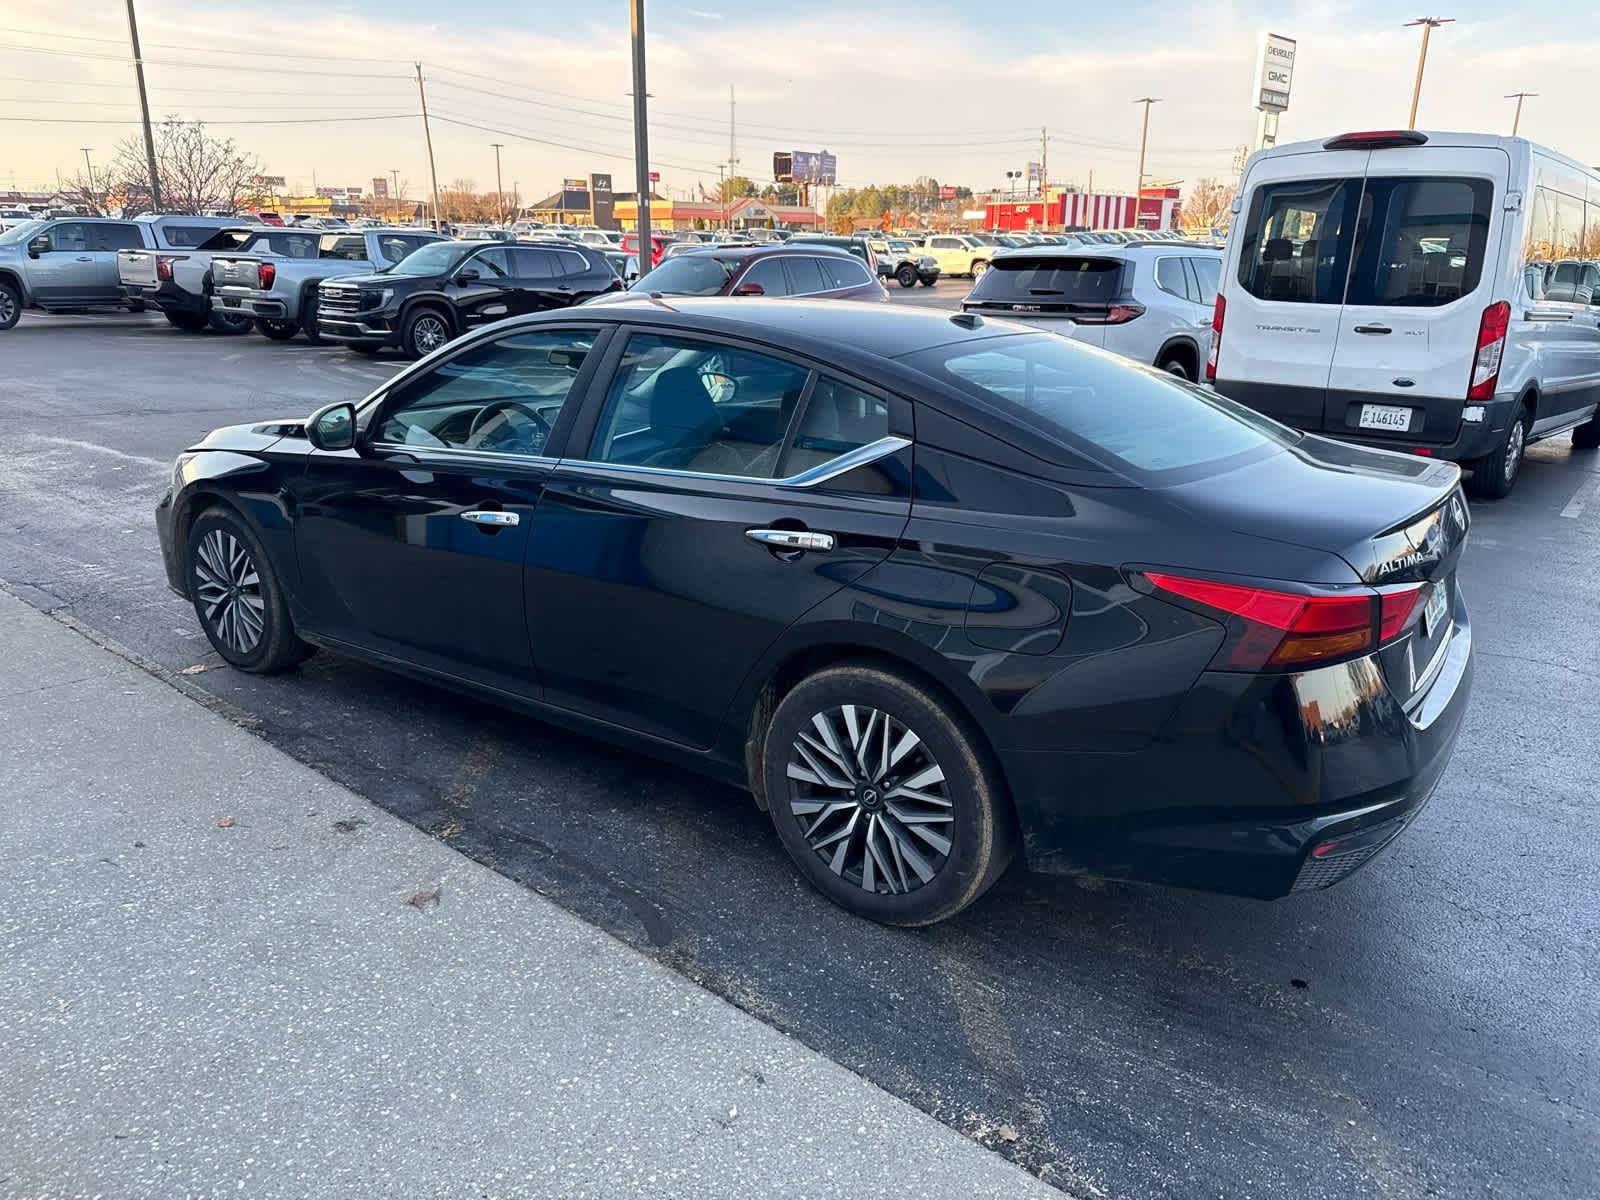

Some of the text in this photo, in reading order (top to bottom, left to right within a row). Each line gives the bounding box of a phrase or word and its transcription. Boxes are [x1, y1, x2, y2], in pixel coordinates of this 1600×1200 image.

[1268, 46, 1293, 60] CHEVROLET
[1268, 71, 1288, 84] GMC
[1015, 205, 1030, 213] KFC
[1012, 304, 1041, 313] GMC
[1370, 411, 1406, 426] 146145
[1379, 552, 1424, 576] ALTIMA
